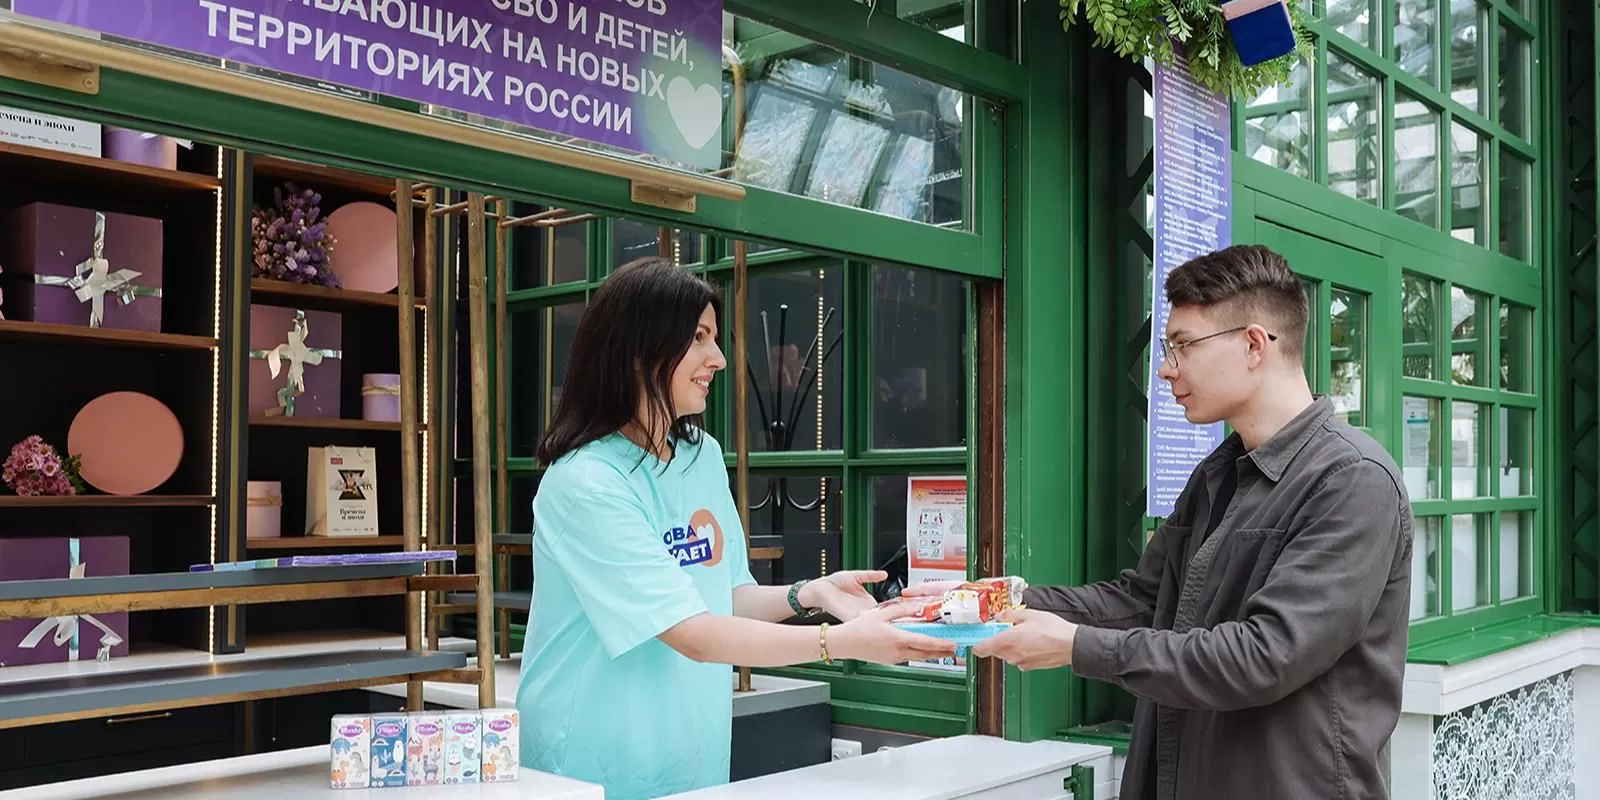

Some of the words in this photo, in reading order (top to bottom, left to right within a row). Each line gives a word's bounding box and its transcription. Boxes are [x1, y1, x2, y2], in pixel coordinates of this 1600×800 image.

[199, 2, 494, 101] ТЕРРИТОРИЯХ
[504, 75, 633, 135] РОССИИ
[503, 28, 547, 68] НА
[557, 44, 666, 101] НОВЫХ
[568, 2, 587, 35] И
[595, 12, 694, 71] ДЕТЕЙ,
